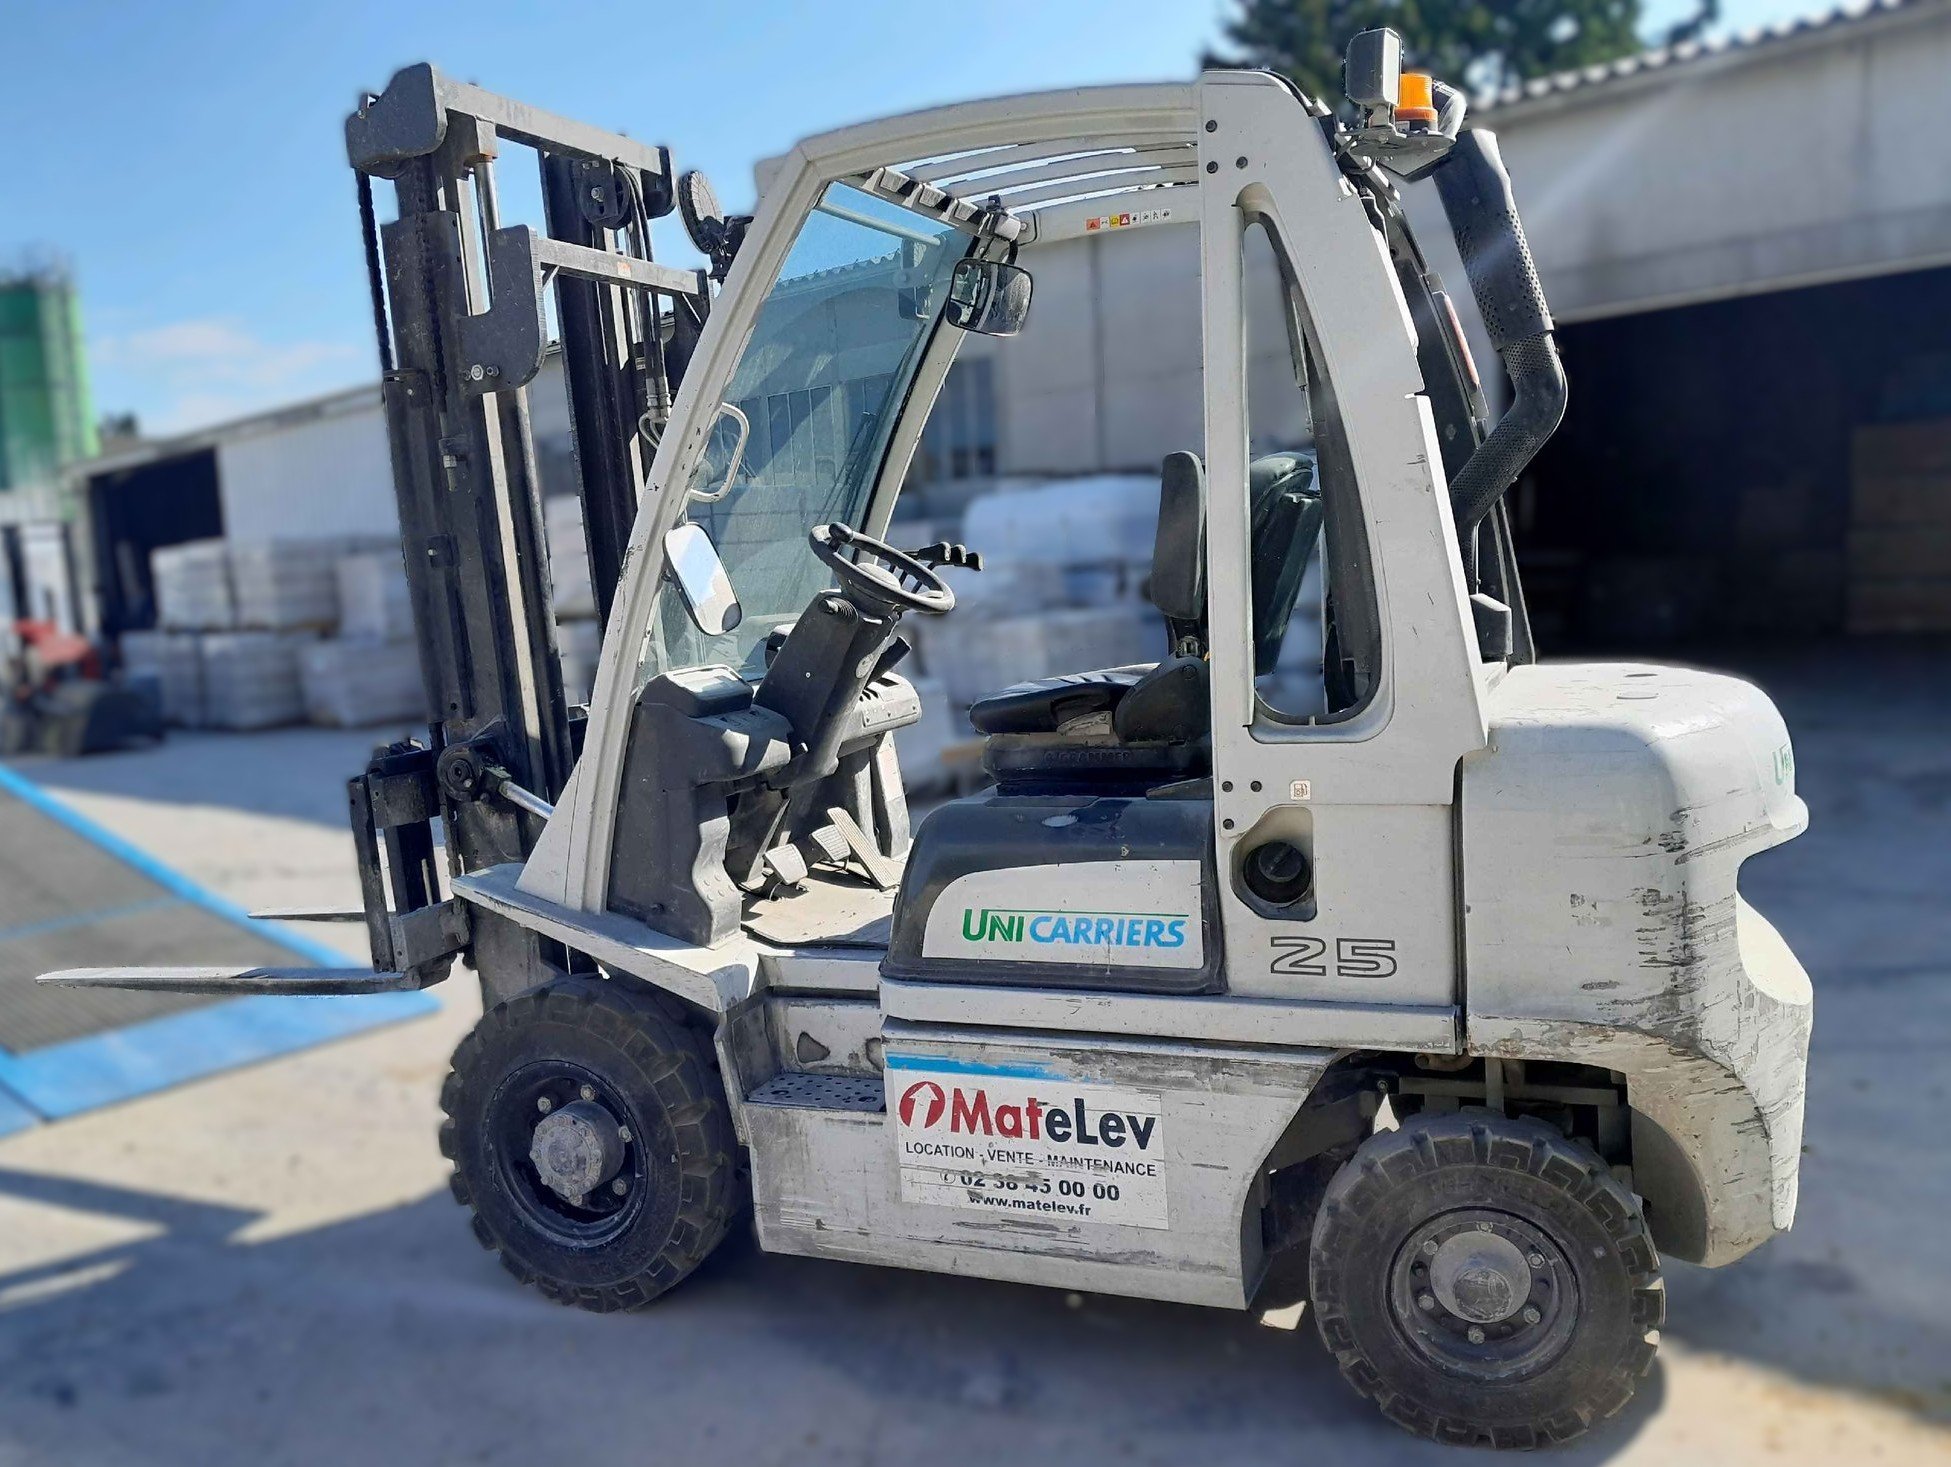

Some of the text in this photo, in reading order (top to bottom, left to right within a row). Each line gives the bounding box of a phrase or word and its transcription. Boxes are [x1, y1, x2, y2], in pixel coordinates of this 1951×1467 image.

[1270, 936, 1398, 979] 25
[950, 1087, 1156, 1151] MateLev
[905, 1141, 975, 1159] LOCATION
[987, 1148, 1034, 1165] VENTE
[1047, 1154, 1157, 1177] MAINTENANCE
[968, 1194, 1092, 1216] www.matelev.fr
[1058, 1179, 1085, 1198] 00
[1092, 1182, 1120, 1201] 00
